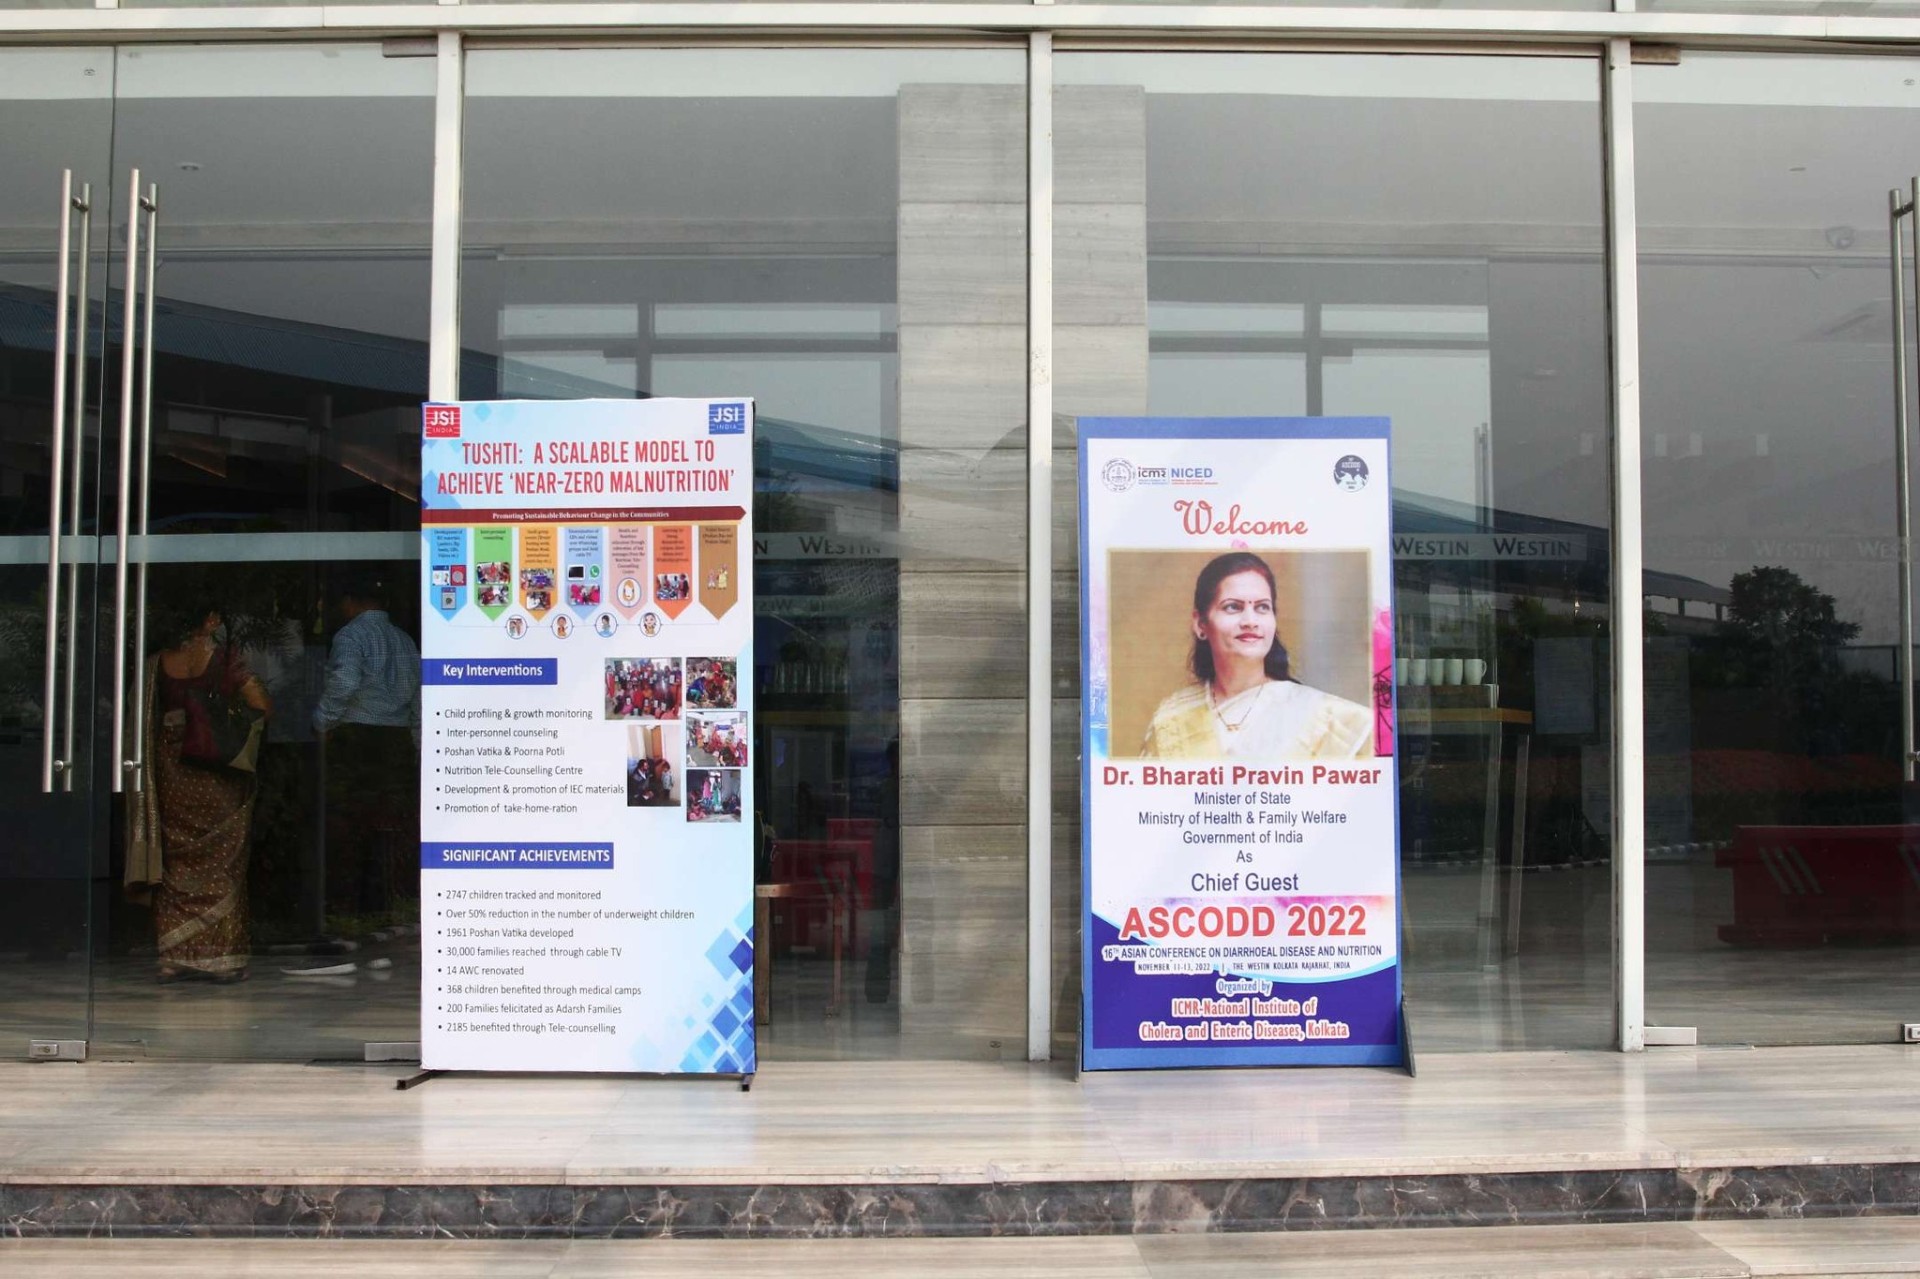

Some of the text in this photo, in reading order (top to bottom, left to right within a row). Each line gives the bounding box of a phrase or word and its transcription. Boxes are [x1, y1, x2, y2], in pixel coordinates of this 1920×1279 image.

[431, 410, 455, 426] JSI
[713, 407, 740, 423] JSI
[716, 423, 737, 431] INDIA
[462, 439, 715, 464] TUSHTI: A SCALABLE MODEL TO
[1171, 468, 1213, 478] NICED
[437, 472, 503, 495] ACHIEVE
[492, 510, 669, 520] Promoting Sustainable Behaviour Change in the Communities
[1173, 499, 1308, 535] Welcome
[443, 664, 543, 678] Key Interventions
[444, 708, 593, 720] Child profiling & growth monitoring
[447, 727, 558, 739] Inter-personnel counseling
[444, 746, 565, 757] Poshan Vatika & Poorna Potli
[444, 765, 583, 777] Nutrition Tele-Counselling Centre
[1103, 765, 1381, 785] Dr. Bharati Pravin Pawar
[444, 784, 625, 795] Development & promotion of IEC materials
[1194, 791, 1291, 805] Minister of State
[444, 803, 578, 814] Promotion of take-home-ration
[1139, 811, 1347, 826] Ministry of Health & Family Welfare
[1183, 831, 1303, 845] Government of India
[443, 849, 610, 862] SIGNIFICANT ACHIEVEMENTS
[1236, 851, 1253, 863] As
[1191, 873, 1299, 892] Chief Guest
[446, 889, 601, 900] 2747 children tracked and monitored
[446, 909, 695, 920] Over 50% reduction in the number of underweight children
[1120, 905, 1366, 938] ASCODD 2022
[447, 928, 574, 939] 1961 Poshan Vatika developed
[446, 947, 622, 958] 30,000 families reached through cable TV
[1121, 945, 1147, 958] ASIAN
[1149, 945, 1207, 958] CONFERENCE
[1208, 945, 1221, 958] ON
[1223, 945, 1278, 958] DIARRHOEAL
[1279, 945, 1316, 958] DISEASE
[1317, 945, 1335, 958] AND
[1337, 945, 1382, 958] NUTRITION
[447, 966, 525, 976] 14 AWC renovated
[1137, 961, 1170, 972] NOVEMBER
[1195, 961, 1210, 972] 2022
[1233, 961, 1245, 972] THE
[1247, 961, 1270, 972] WESTIN
[1273, 961, 1299, 972] KOLKATA
[1301, 961, 1332, 972] RAJARHAT,
[1333, 961, 1350, 972] INDIA
[447, 984, 642, 996] 368 children benefited through medical camps
[1217, 981, 1272, 994] Organized by
[447, 1003, 622, 1015] 200 Families felicitated as Adarsh Families
[1173, 998, 1317, 1015] ICMR-National Institute of
[447, 1022, 616, 1034] 2185 benefited through Tele-counselling
[1141, 1021, 1348, 1041] Cholera and Enteric Diseases, Kolkata
